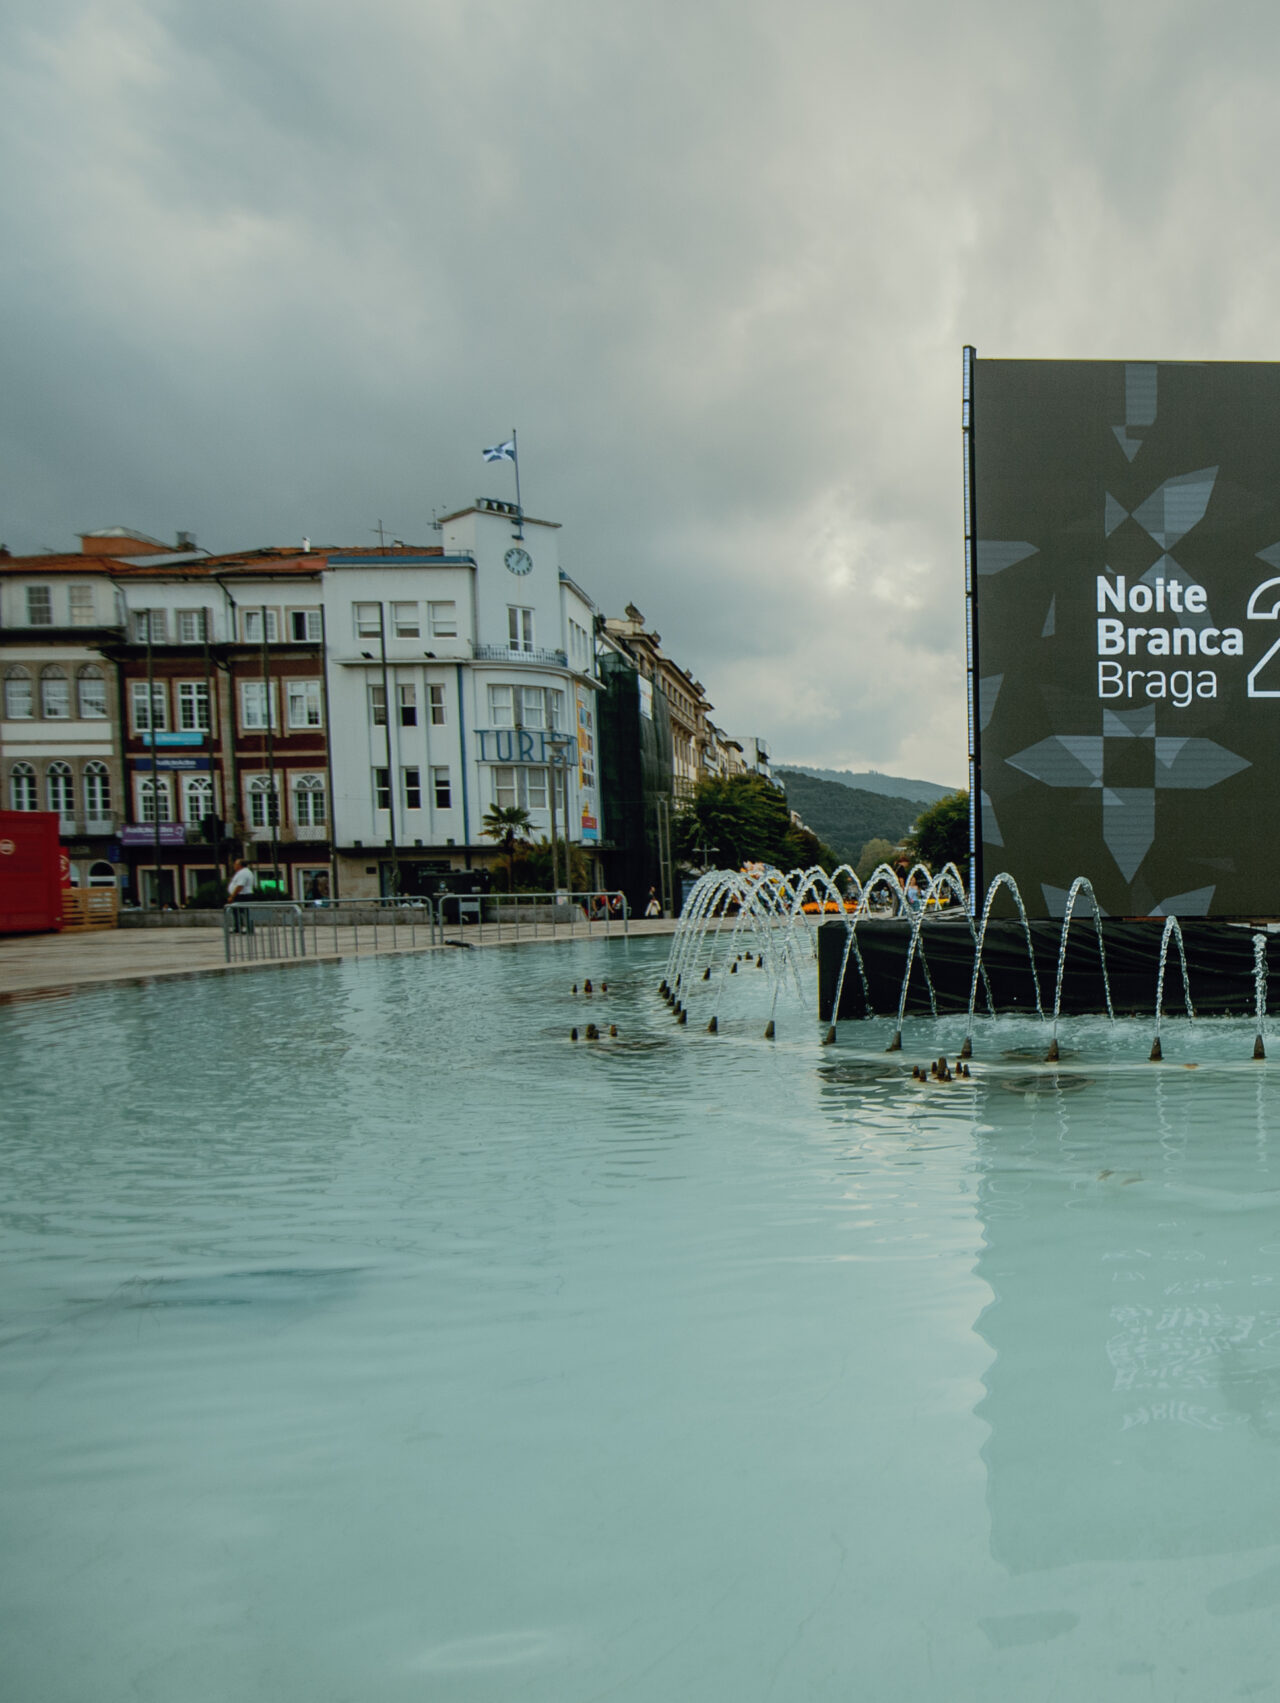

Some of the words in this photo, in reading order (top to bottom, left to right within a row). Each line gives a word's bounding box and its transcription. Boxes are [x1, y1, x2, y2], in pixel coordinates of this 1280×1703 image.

[1096, 575, 1208, 613] Noite
[1097, 618, 1244, 656] Branca
[1098, 661, 1217, 708] Braga
